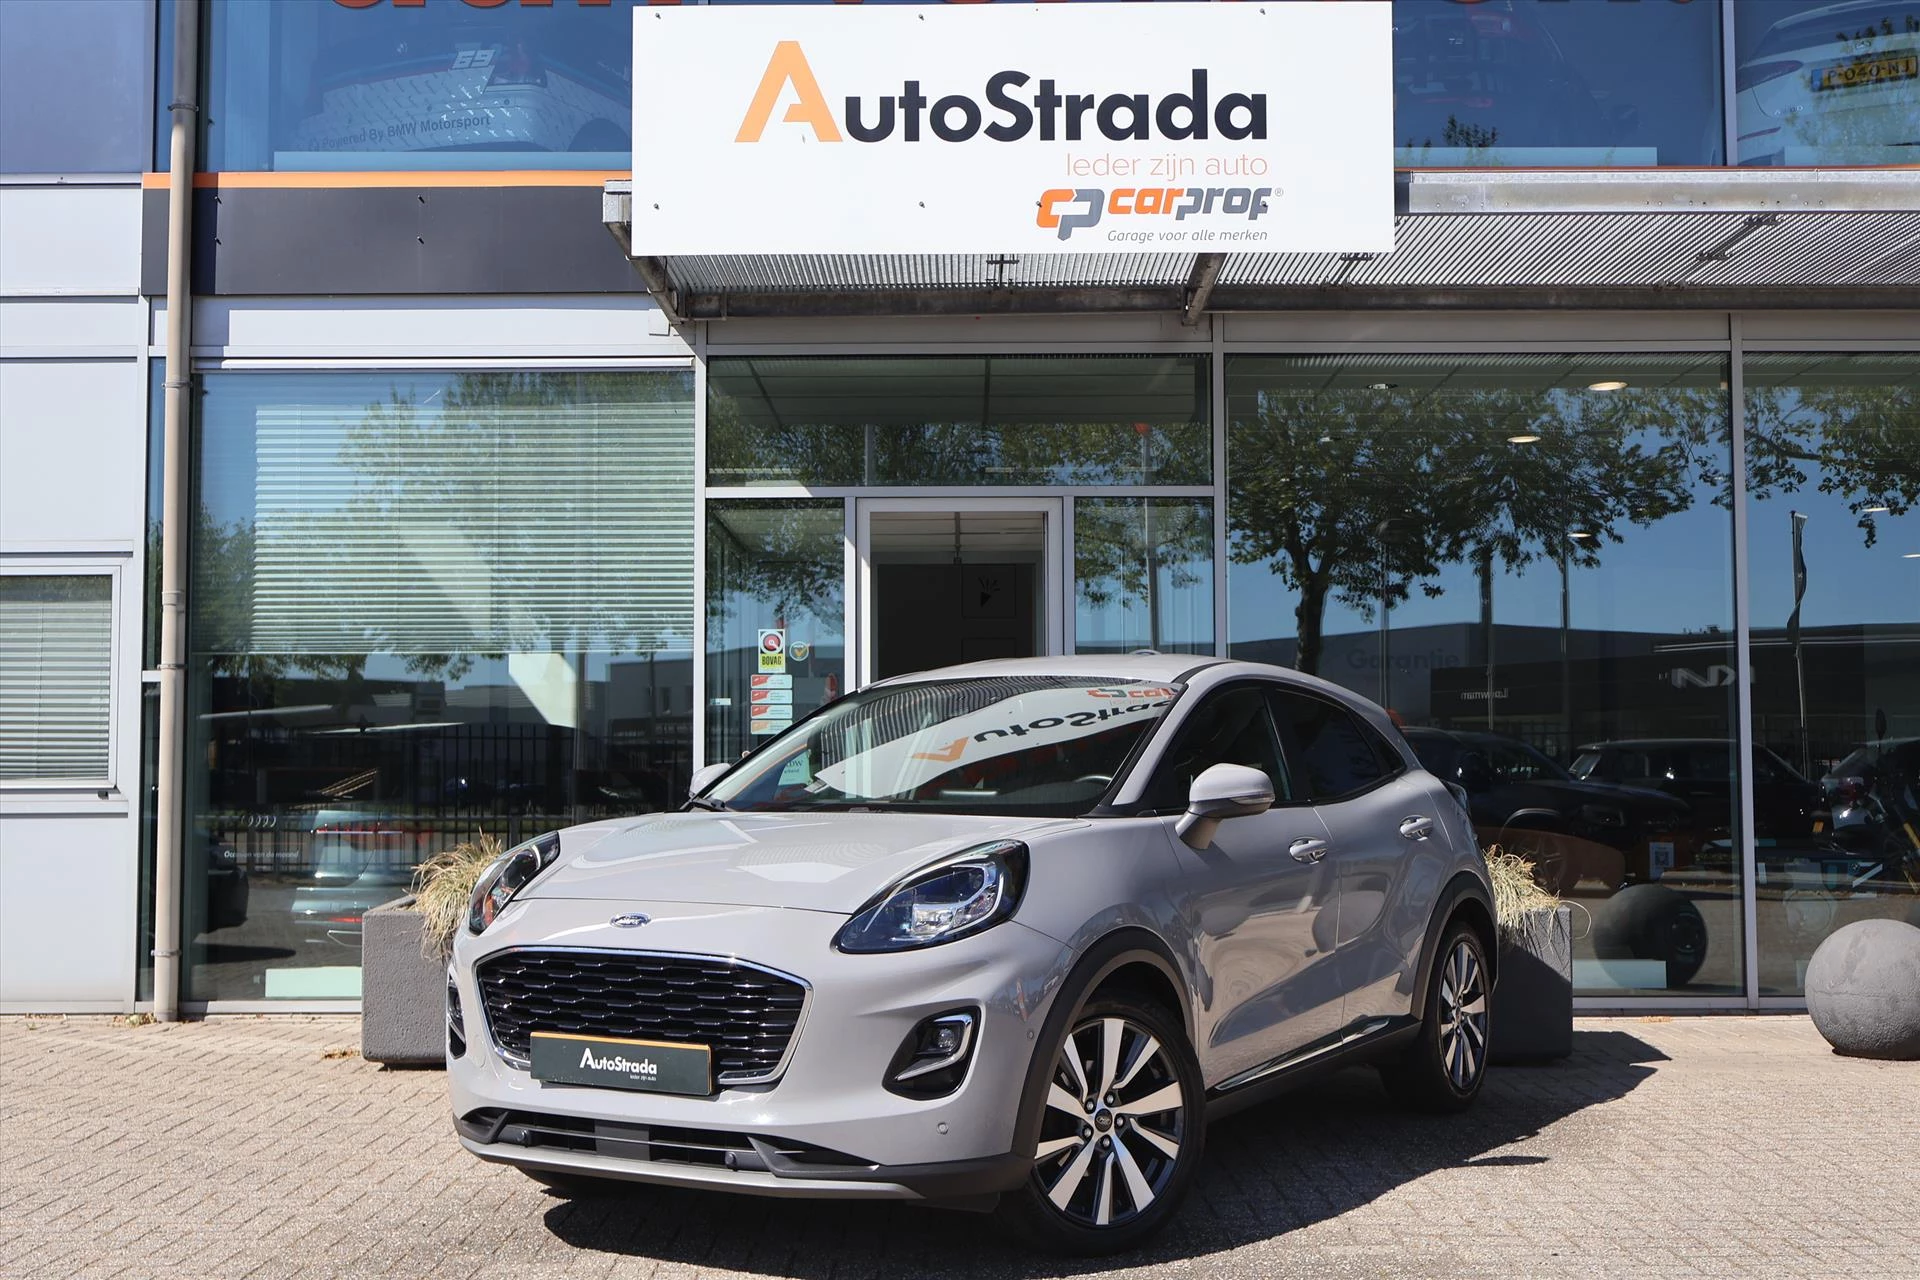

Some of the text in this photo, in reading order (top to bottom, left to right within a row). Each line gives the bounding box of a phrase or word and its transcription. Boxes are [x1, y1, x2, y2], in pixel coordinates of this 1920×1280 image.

[734, 41, 1267, 143] AutoStrada
[322, 115, 491, 149] Powered By BMW Motorsport
[1066, 153, 1269, 182] Ieder zijn auto
[1107, 187, 1272, 221] carprof
[1107, 230, 1268, 244] Garage voor alle merken
[761, 655, 782, 666] BOVAG
[579, 1048, 657, 1075] AutoStrada
